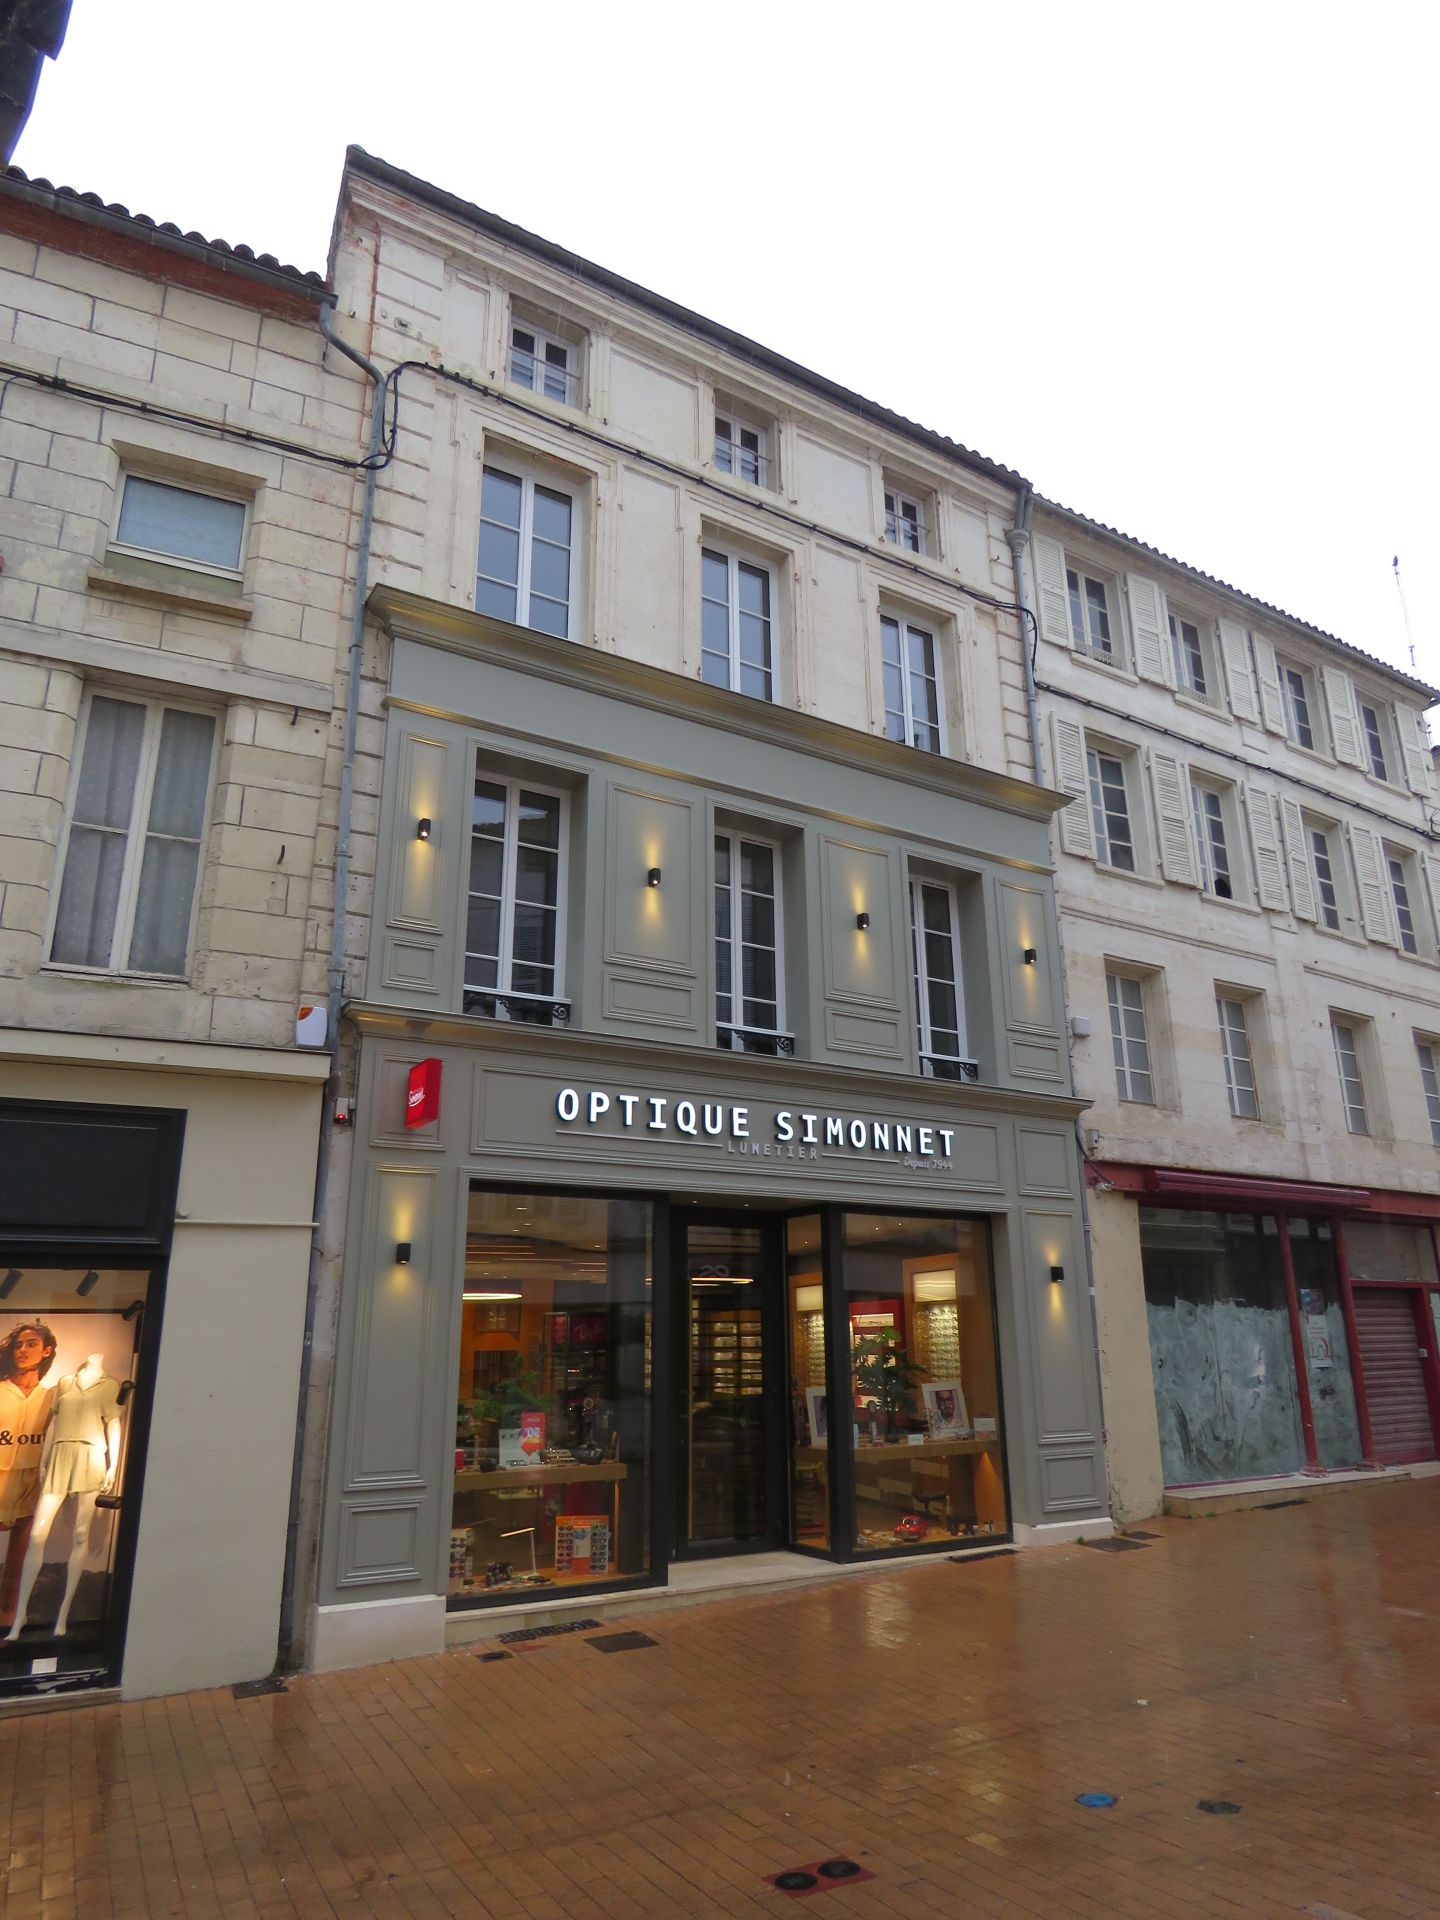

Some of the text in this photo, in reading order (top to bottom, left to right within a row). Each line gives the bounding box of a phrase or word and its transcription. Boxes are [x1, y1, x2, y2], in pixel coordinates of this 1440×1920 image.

[557, 1088, 955, 1156] OPTIQUE SIMONNET
[727, 1140, 818, 1160] LUNETIER
[903, 1156, 930, 1170] Depuis
